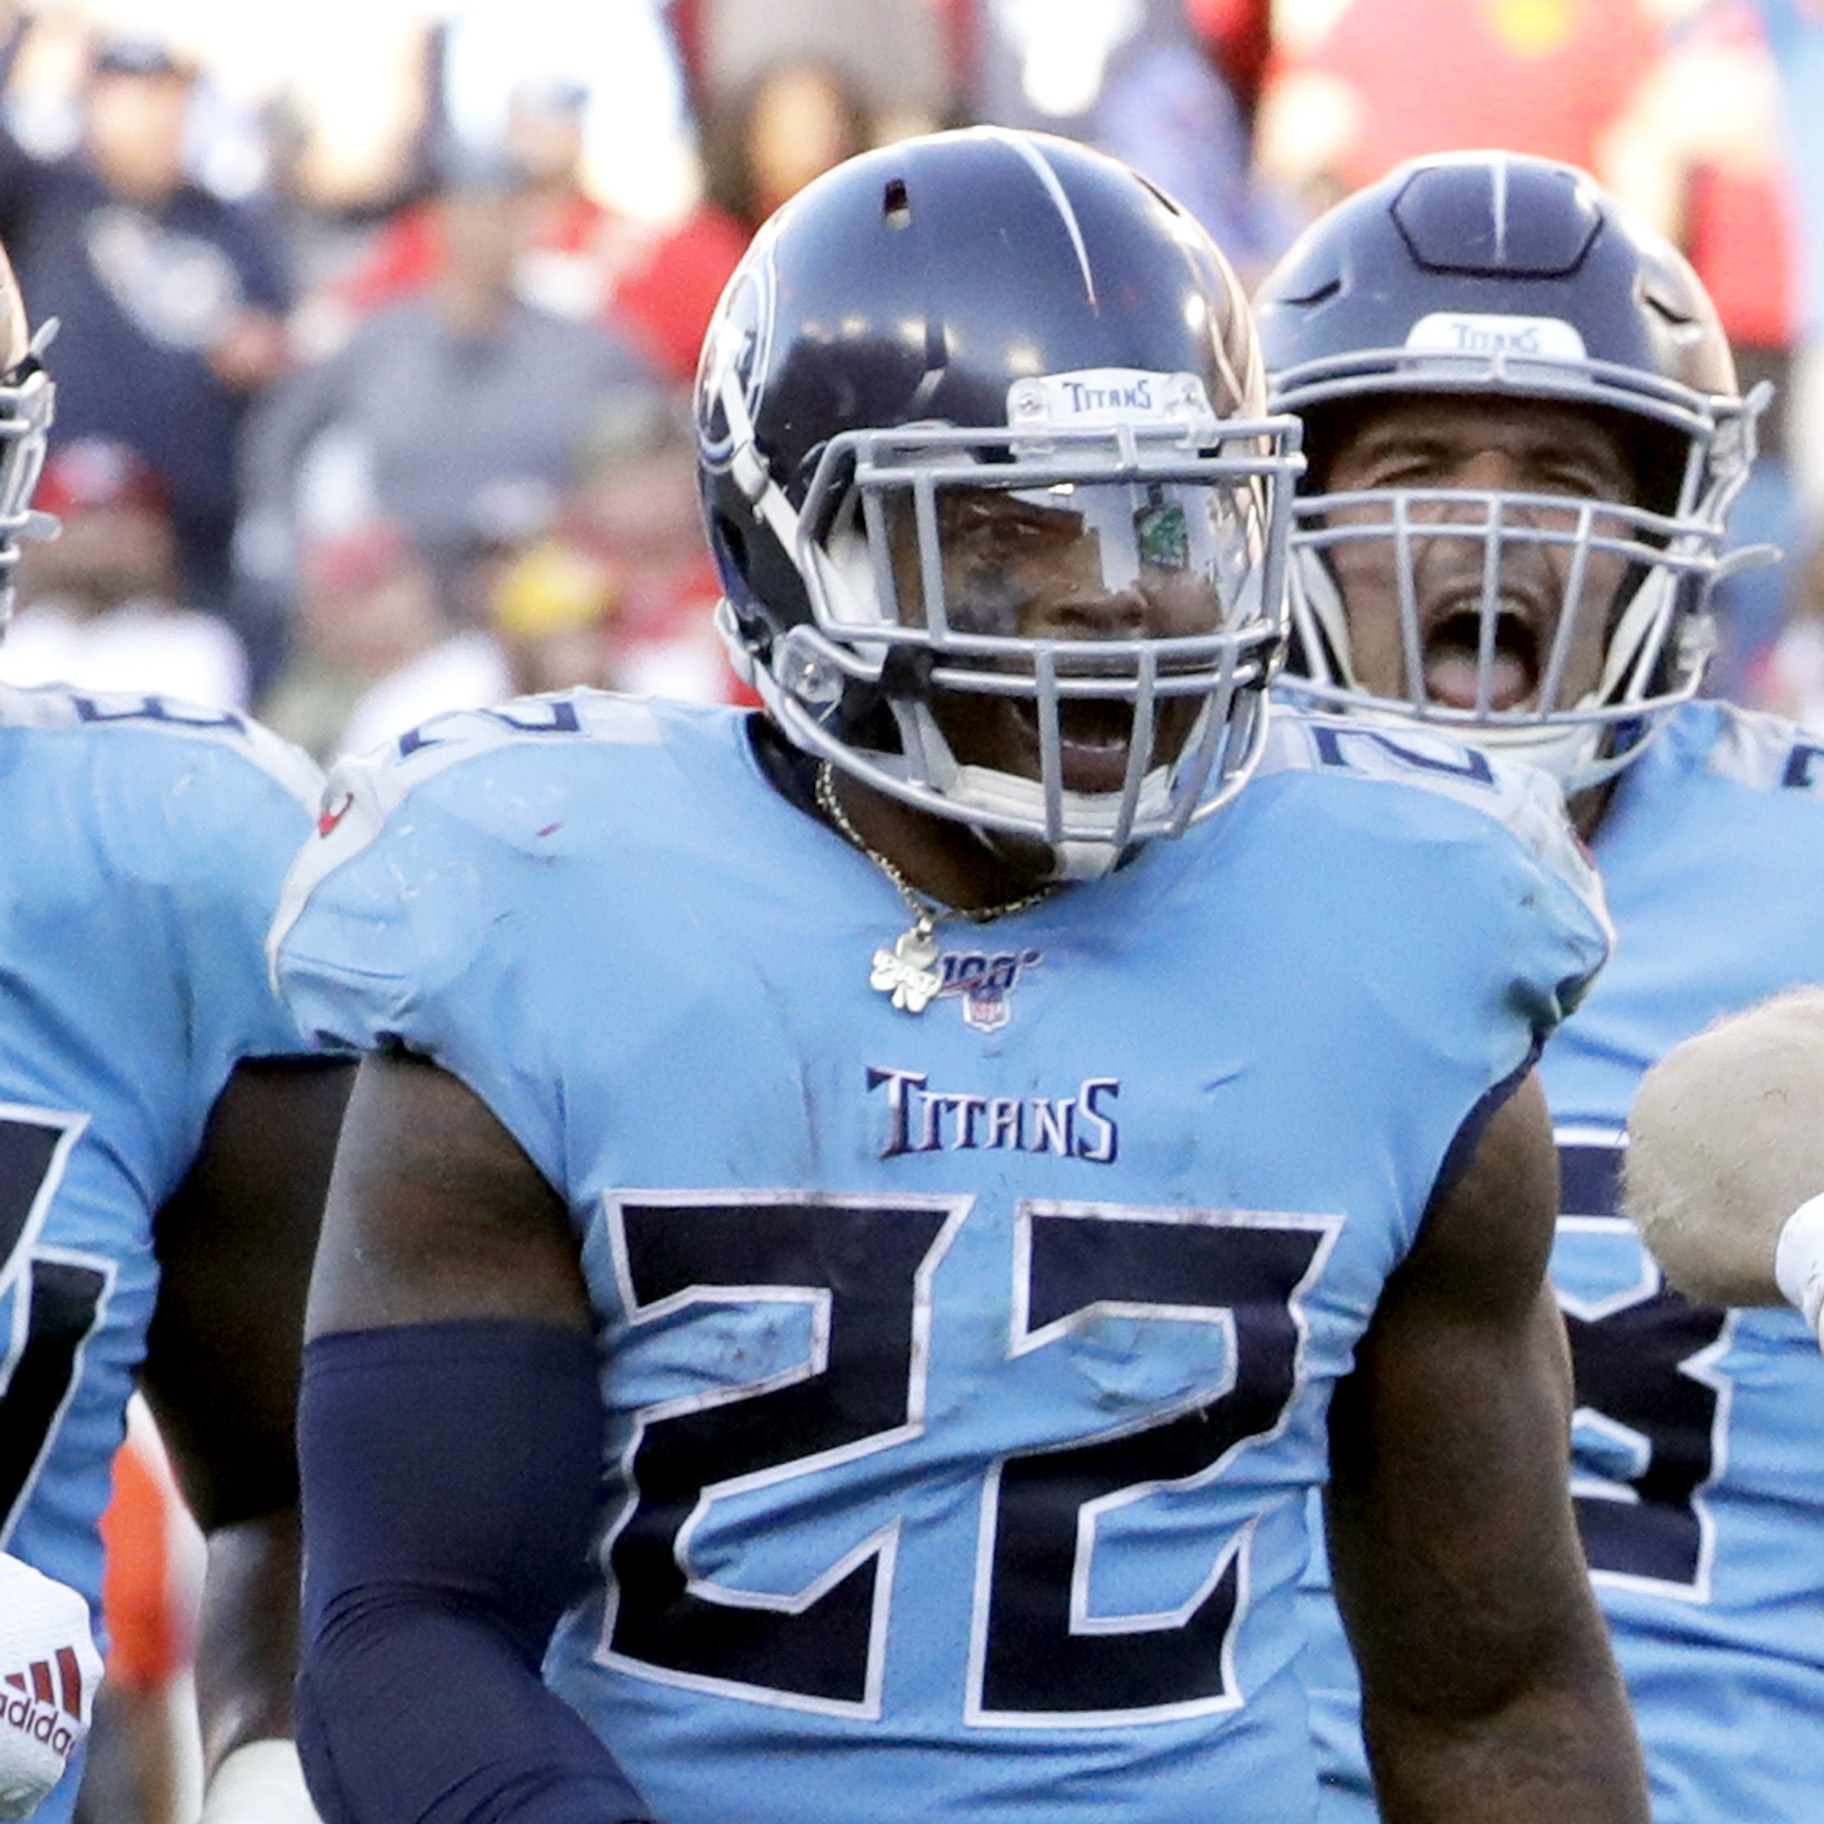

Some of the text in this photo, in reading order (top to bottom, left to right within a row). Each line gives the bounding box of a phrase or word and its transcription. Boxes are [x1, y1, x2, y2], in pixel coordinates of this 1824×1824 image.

[1061, 379, 1152, 413] TITANS
[865, 1066, 1121, 1165] TITANS
[595, 1188, 1345, 1729] 22
[0, 1692, 77, 1758] dida
